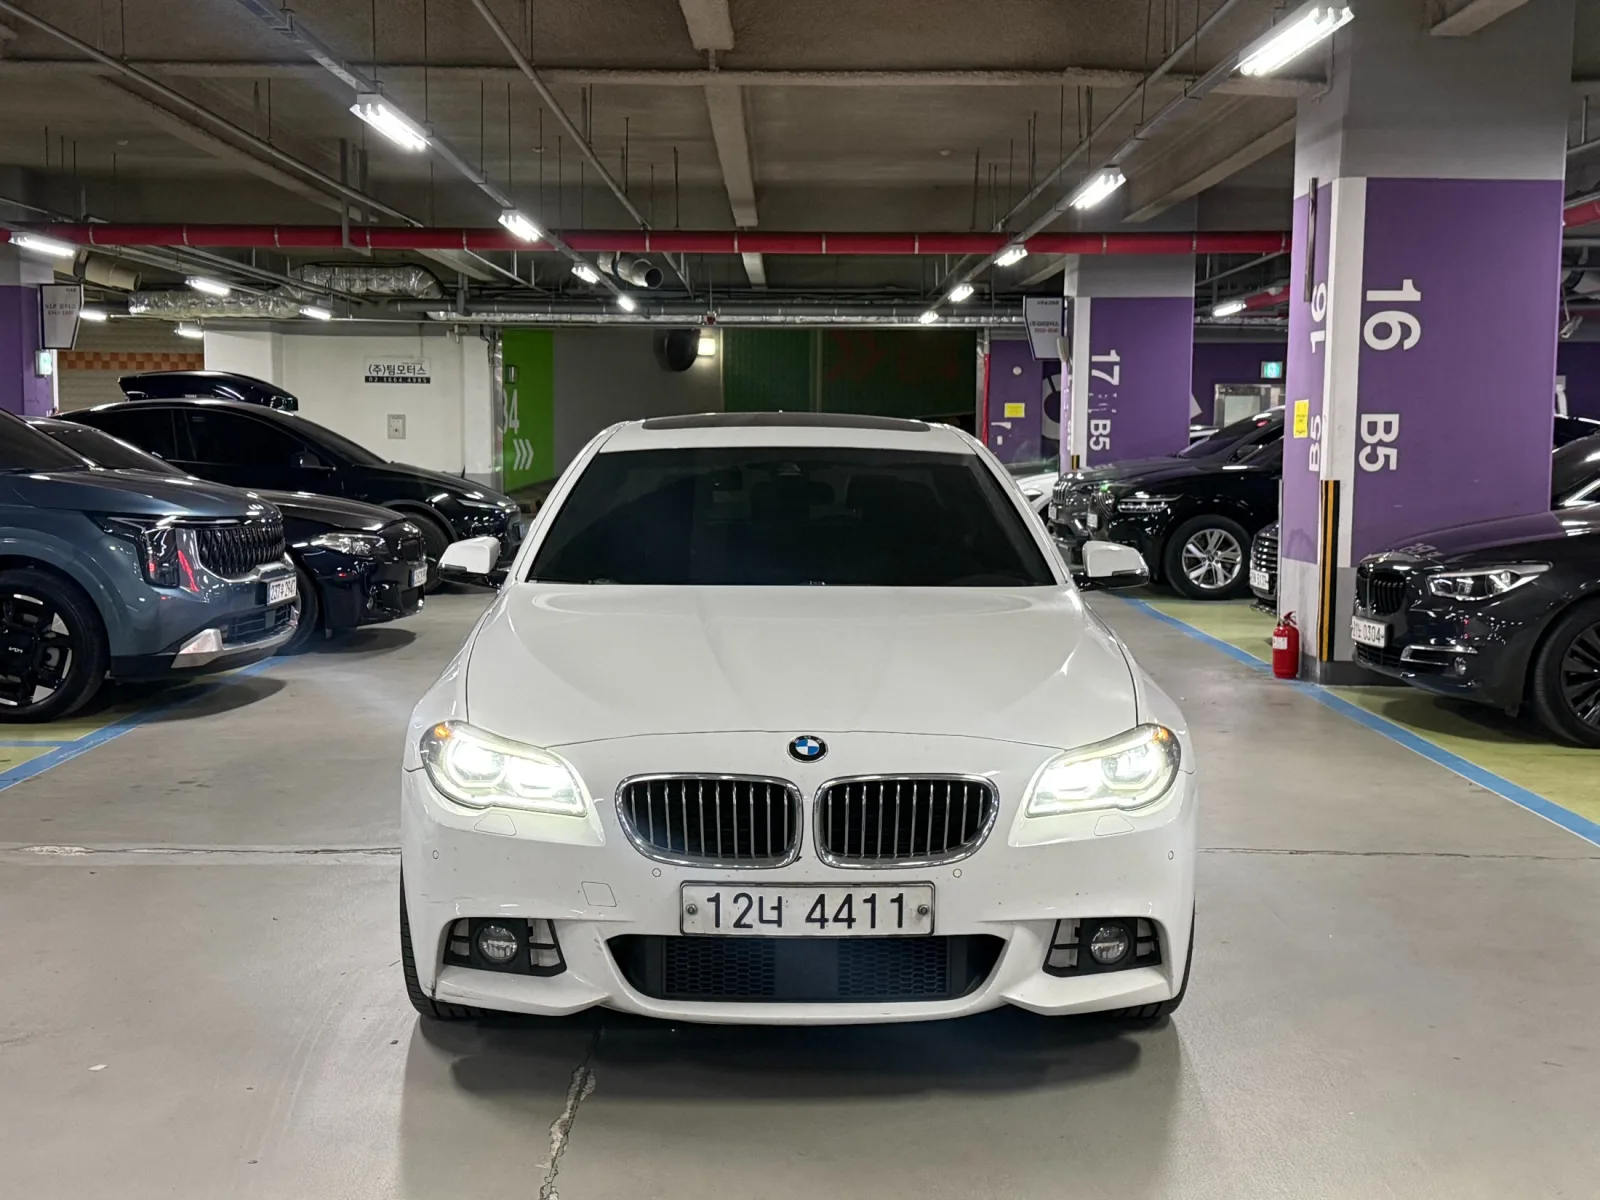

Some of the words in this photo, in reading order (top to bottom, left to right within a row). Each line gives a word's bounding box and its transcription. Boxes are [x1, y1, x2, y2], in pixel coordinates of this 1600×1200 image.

[1310, 282, 1327, 354] 16
[1363, 278, 1421, 351] 16
[1091, 349, 1120, 386] 17
[1089, 419, 1111, 451] B5
[1308, 414, 1322, 472] B5
[1358, 413, 1400, 472] B5
[706, 891, 783, 929] 12너
[804, 892, 904, 930] 4411
